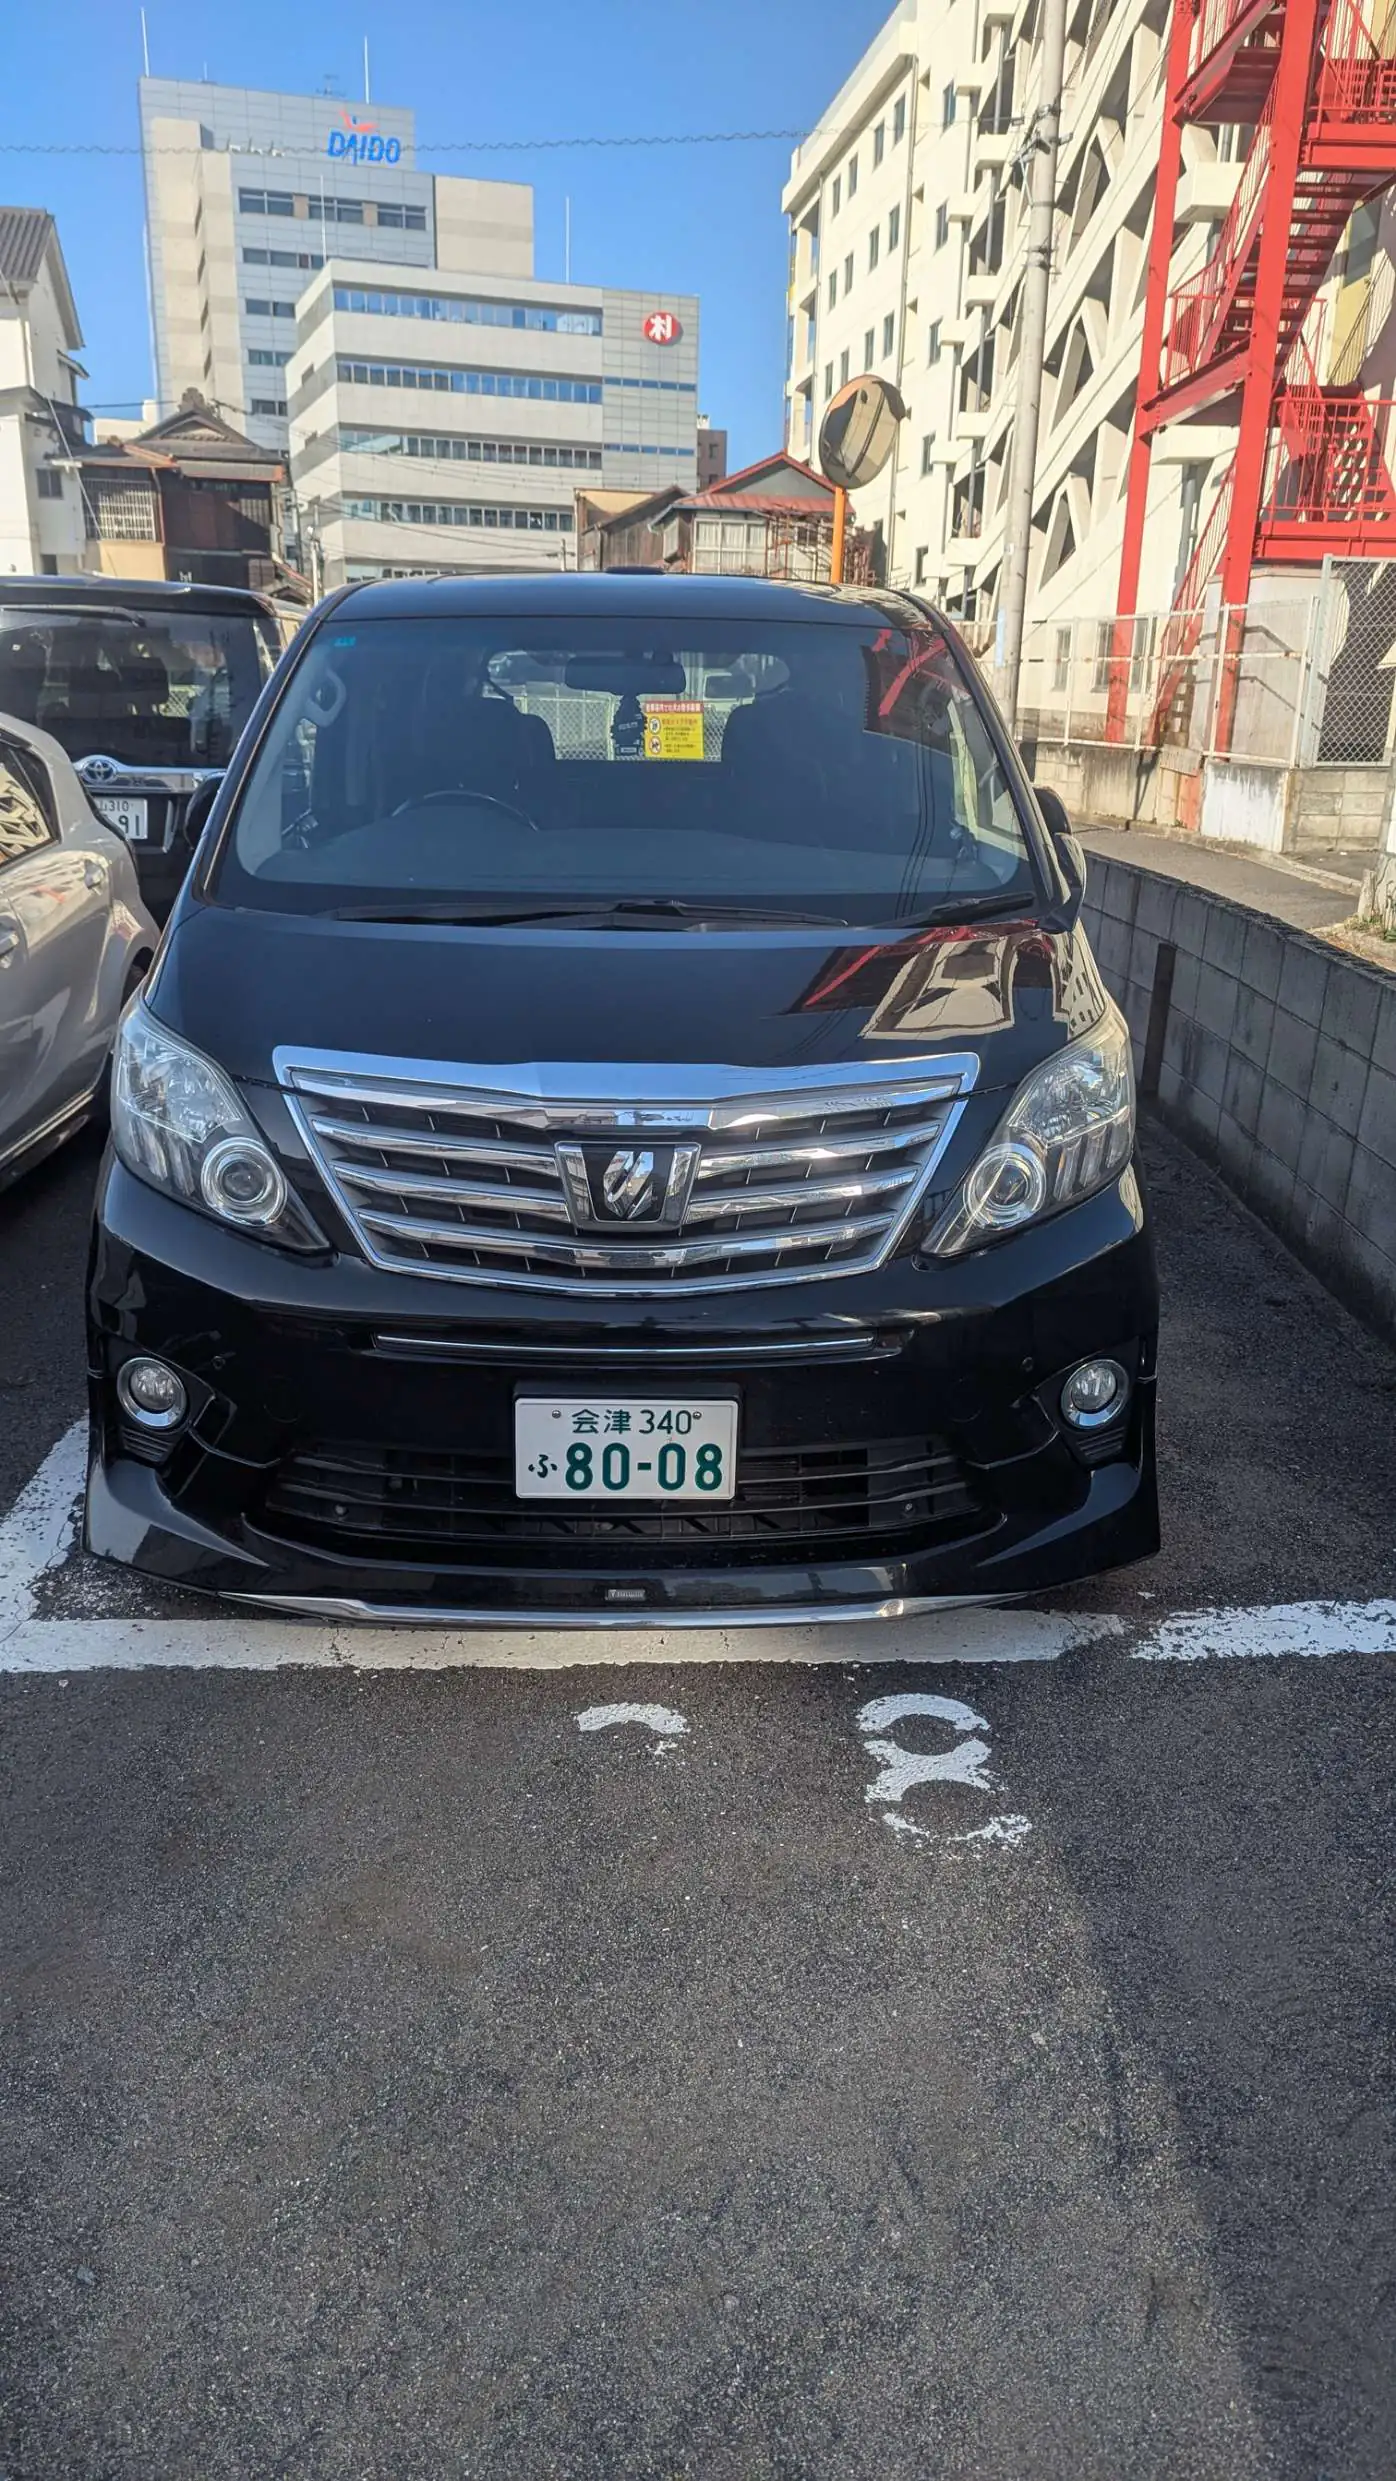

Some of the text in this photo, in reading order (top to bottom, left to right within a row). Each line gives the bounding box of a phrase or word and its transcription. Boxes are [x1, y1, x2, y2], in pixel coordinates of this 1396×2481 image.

[327, 131, 401, 165] DAIDO
[109, 800, 129, 812] 310
[571, 1408, 692, 1435] 会津 340
[528, 1442, 723, 1491] ふ 80-08
